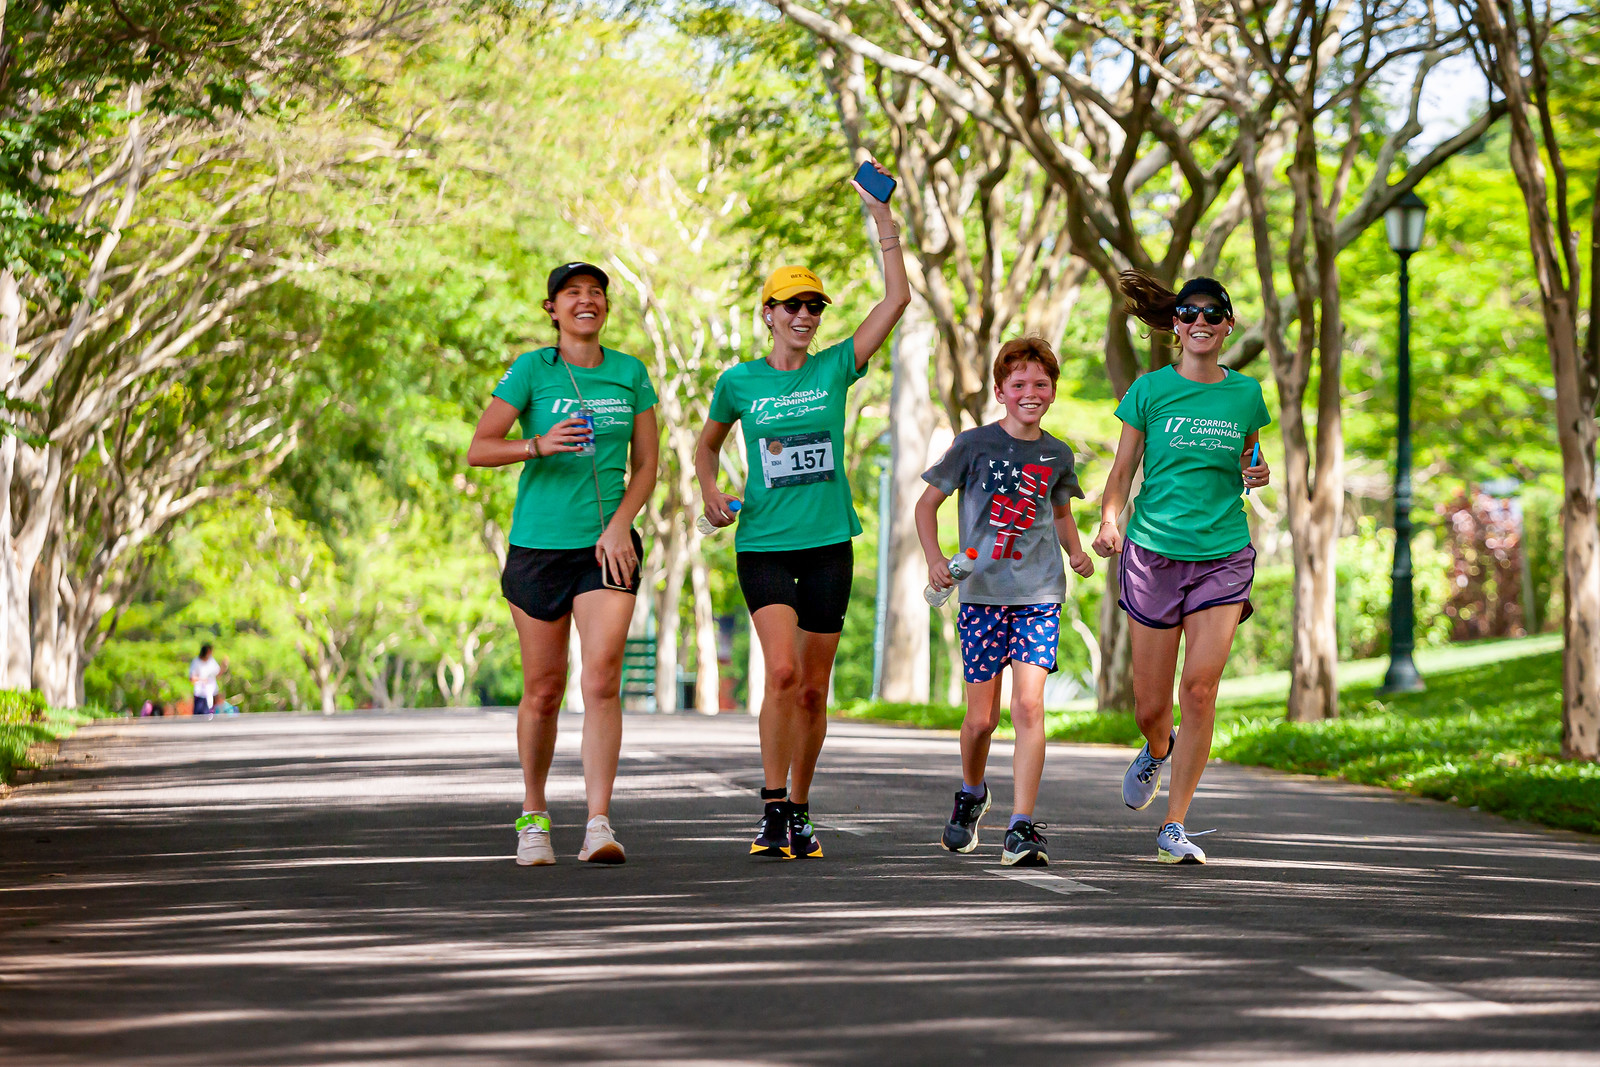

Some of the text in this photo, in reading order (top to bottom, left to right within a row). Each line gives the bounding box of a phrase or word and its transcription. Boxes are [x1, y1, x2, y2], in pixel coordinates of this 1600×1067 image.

[1190, 427, 1240, 439] CAMINHADA
[1193, 418, 1232, 429] CORRIDA
[1233, 422, 1239, 431] E
[790, 447, 827, 471] 157
[982, 459, 1053, 499] JUST
[989, 494, 1036, 530] DO
